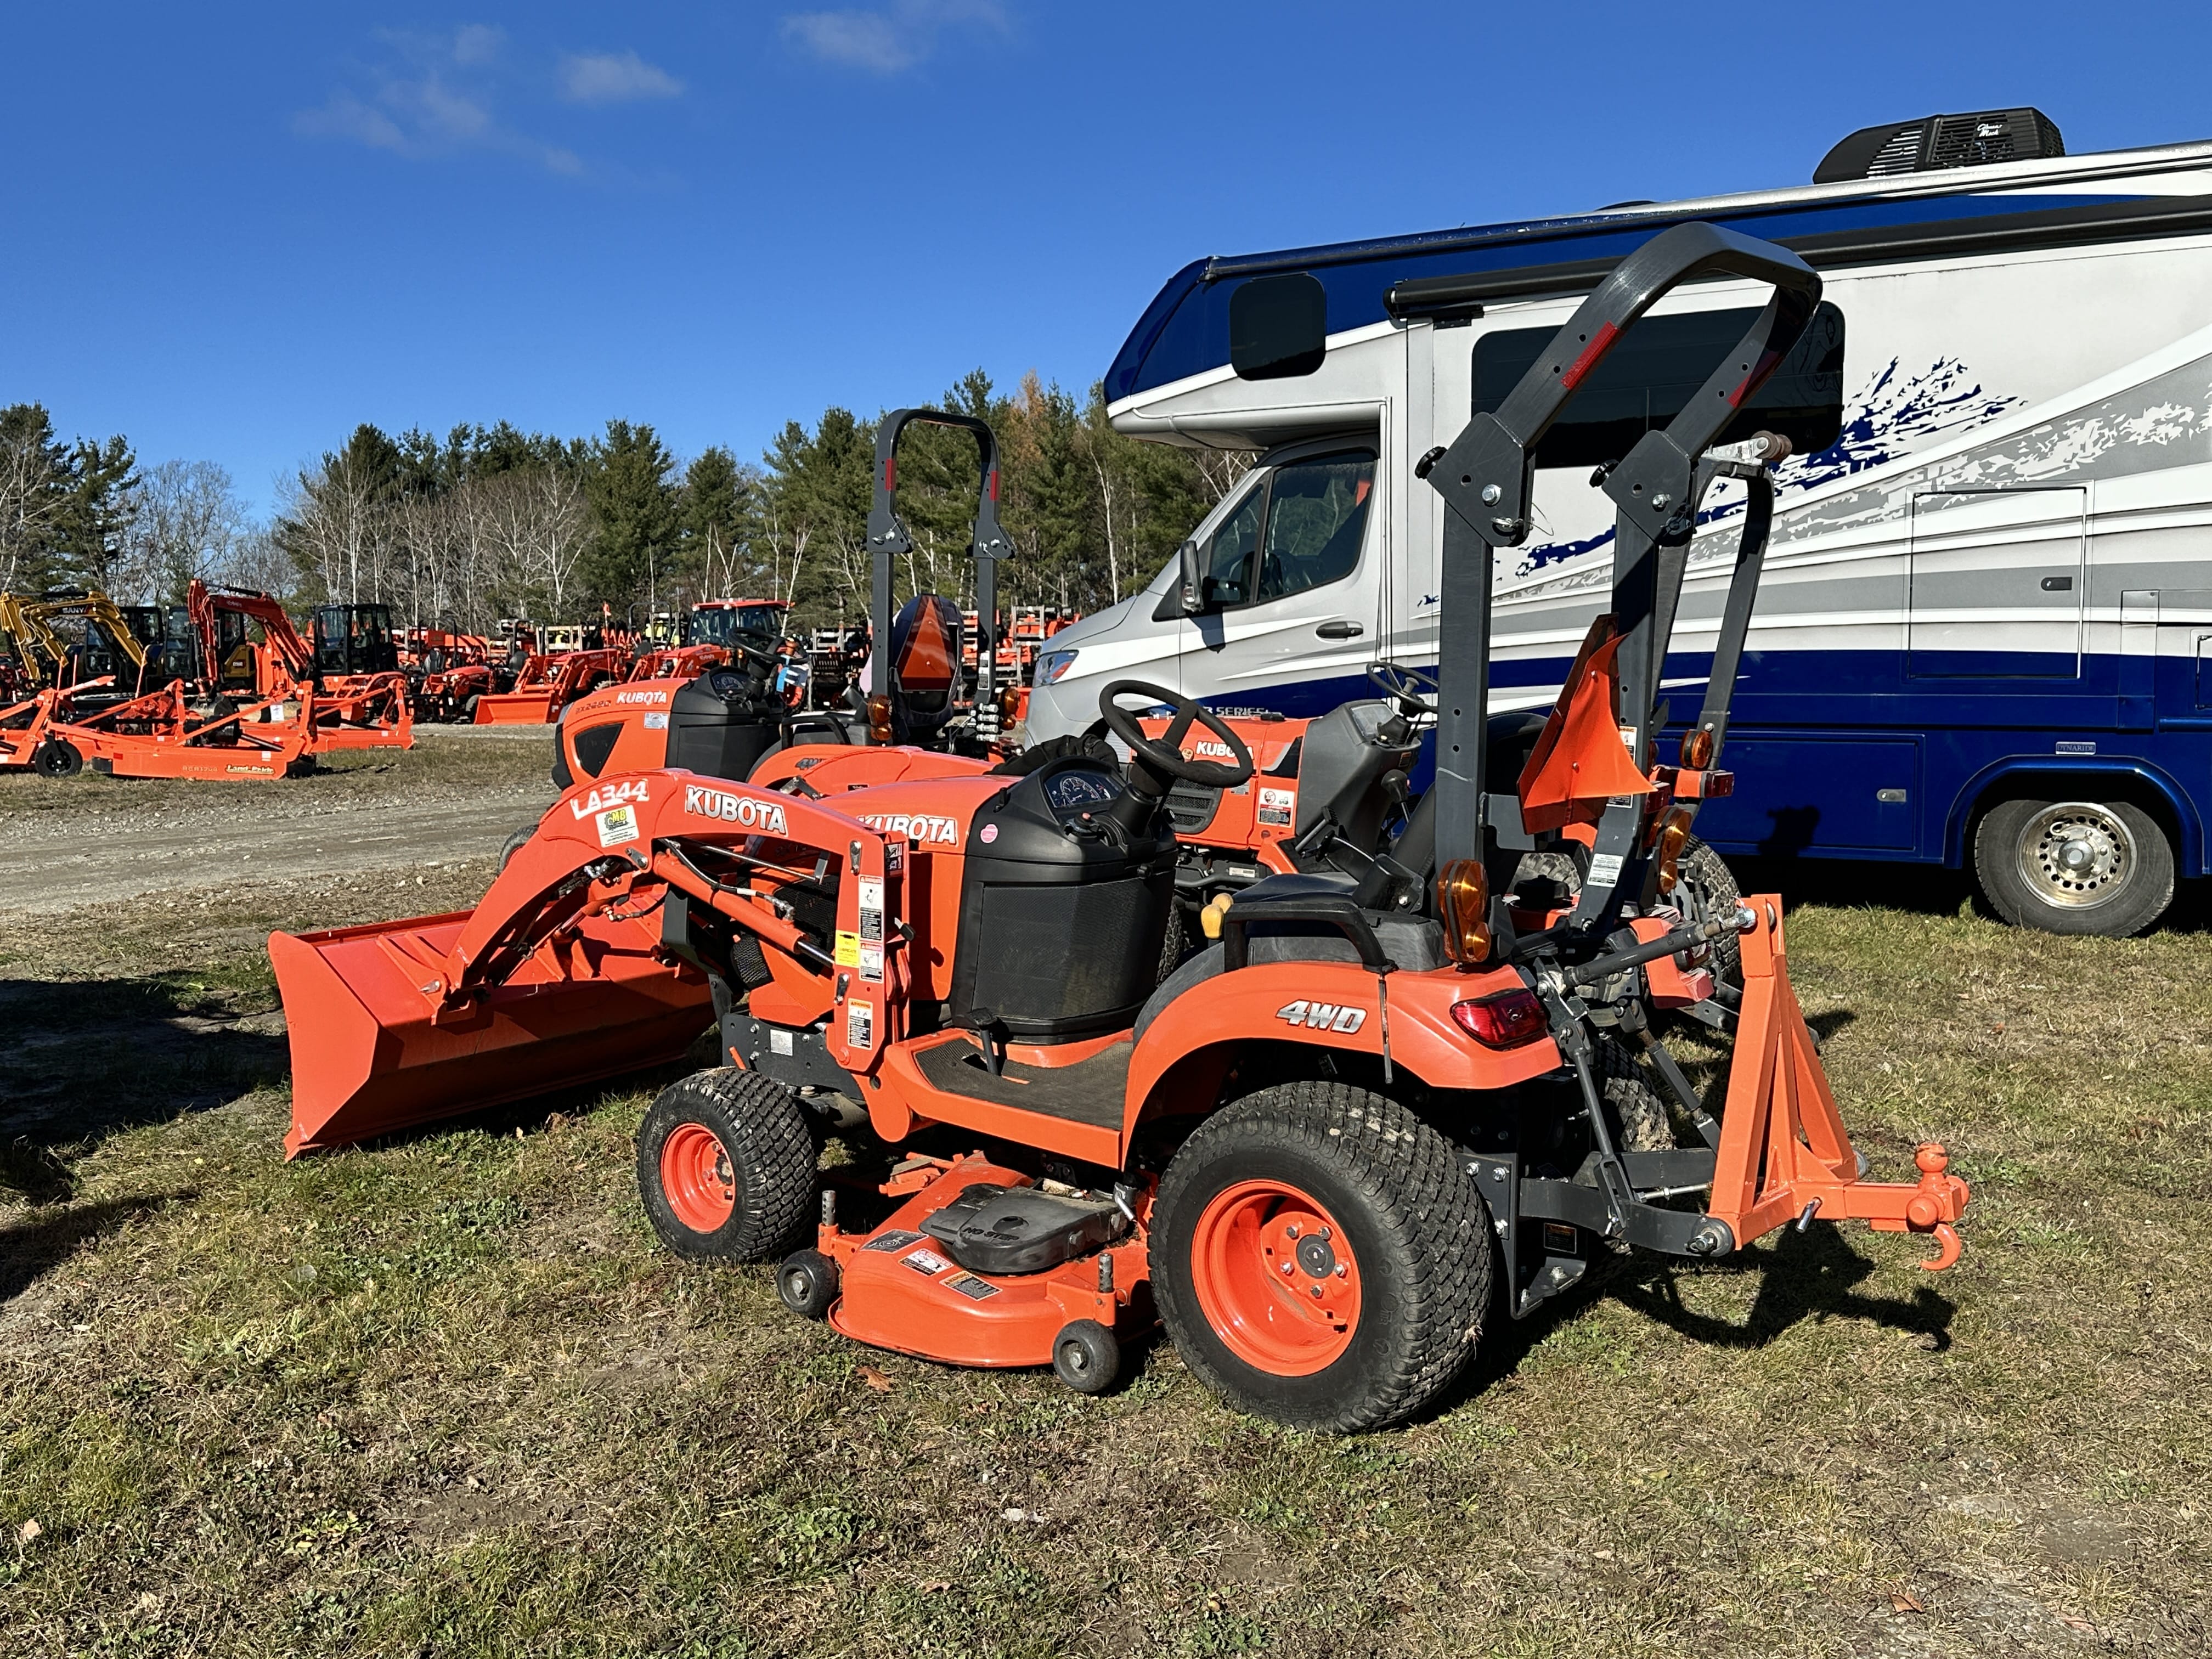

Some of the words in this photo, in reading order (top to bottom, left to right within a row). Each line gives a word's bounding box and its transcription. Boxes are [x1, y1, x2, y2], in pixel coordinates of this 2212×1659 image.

[616, 691, 668, 705] KUBOTA
[571, 780, 648, 820] LA344
[686, 786, 787, 836] KUBOTA
[1275, 998, 1368, 1035] 4WD
